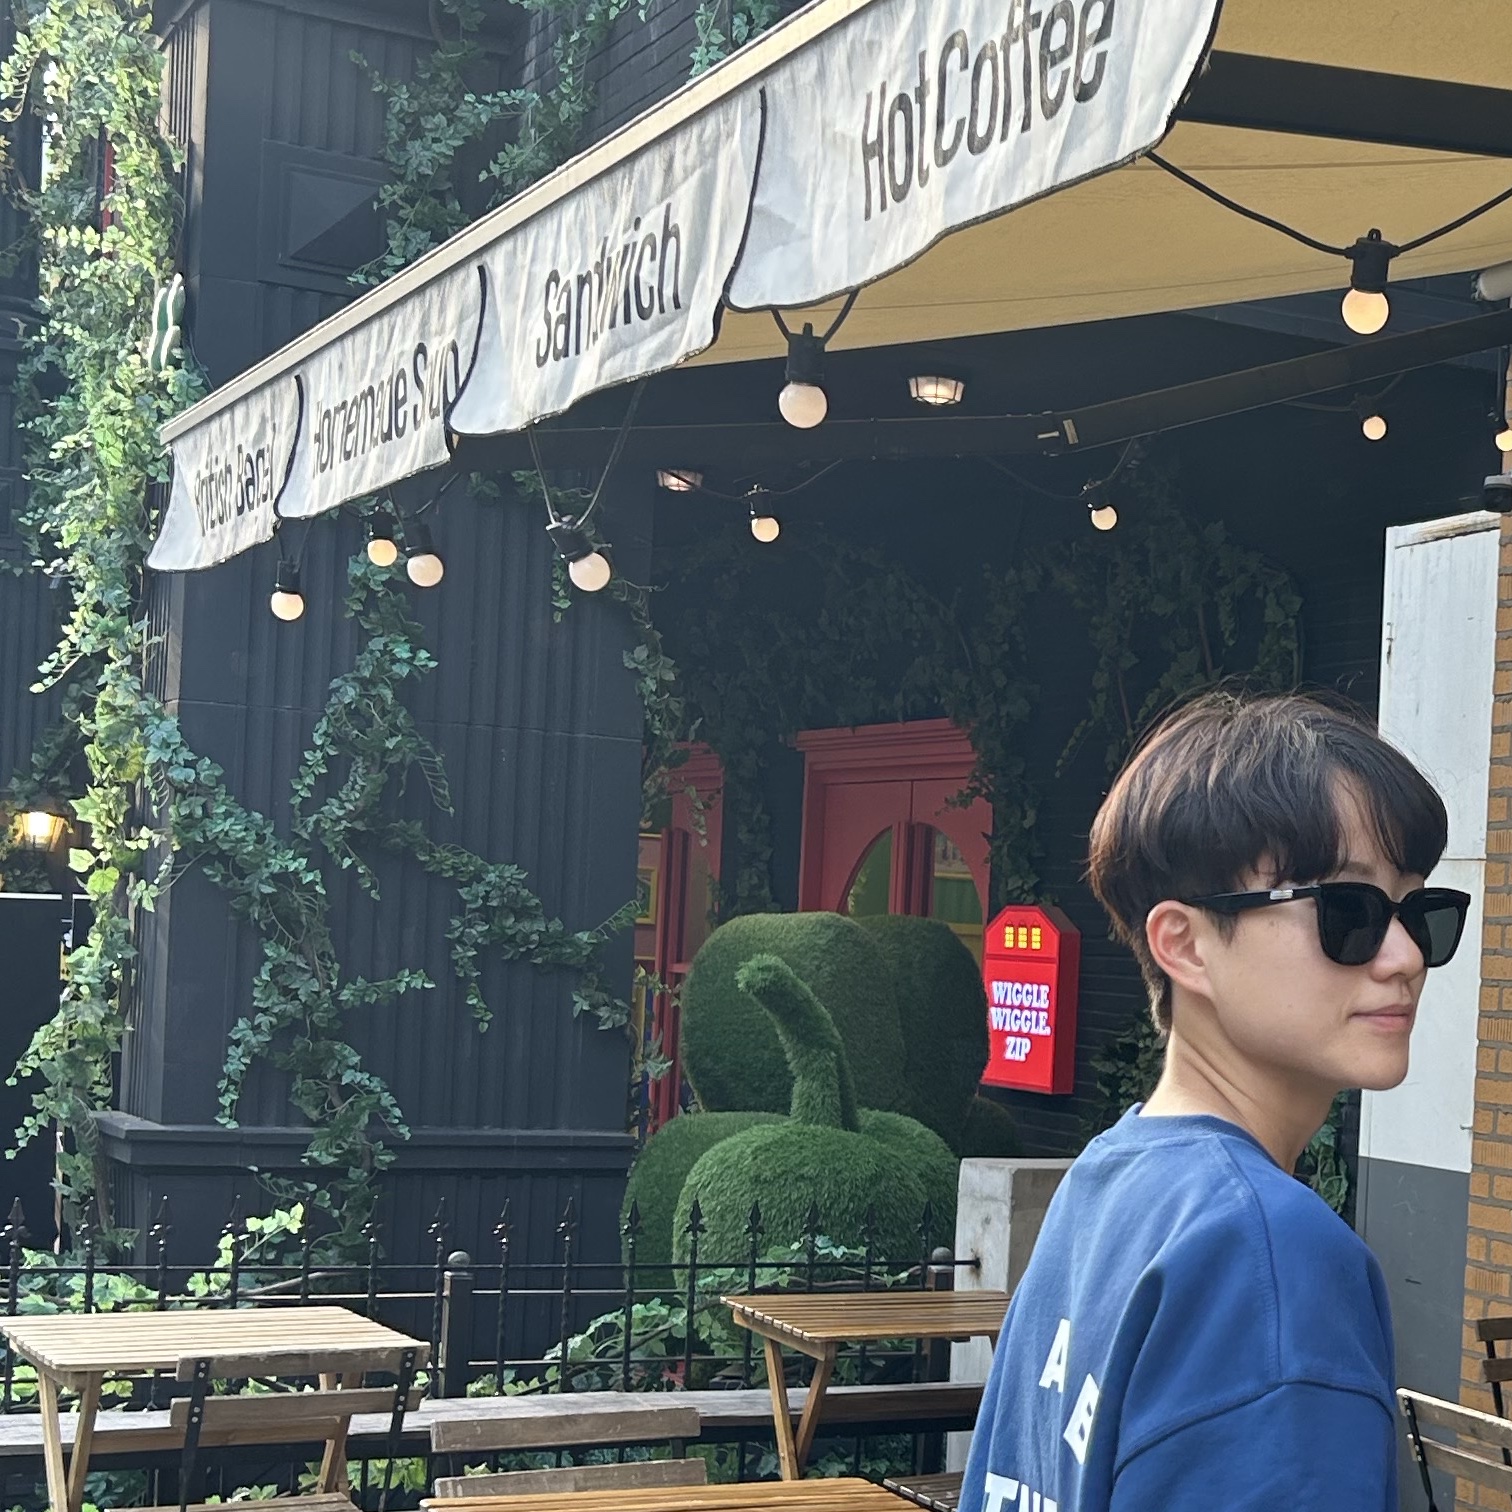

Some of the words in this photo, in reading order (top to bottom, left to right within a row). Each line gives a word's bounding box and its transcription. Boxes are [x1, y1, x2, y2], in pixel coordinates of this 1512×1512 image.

[536, 202, 681, 368] Sandwich
[991, 981, 1050, 1008] WIGGLE
[1004, 1036, 1031, 1062] ZIP
